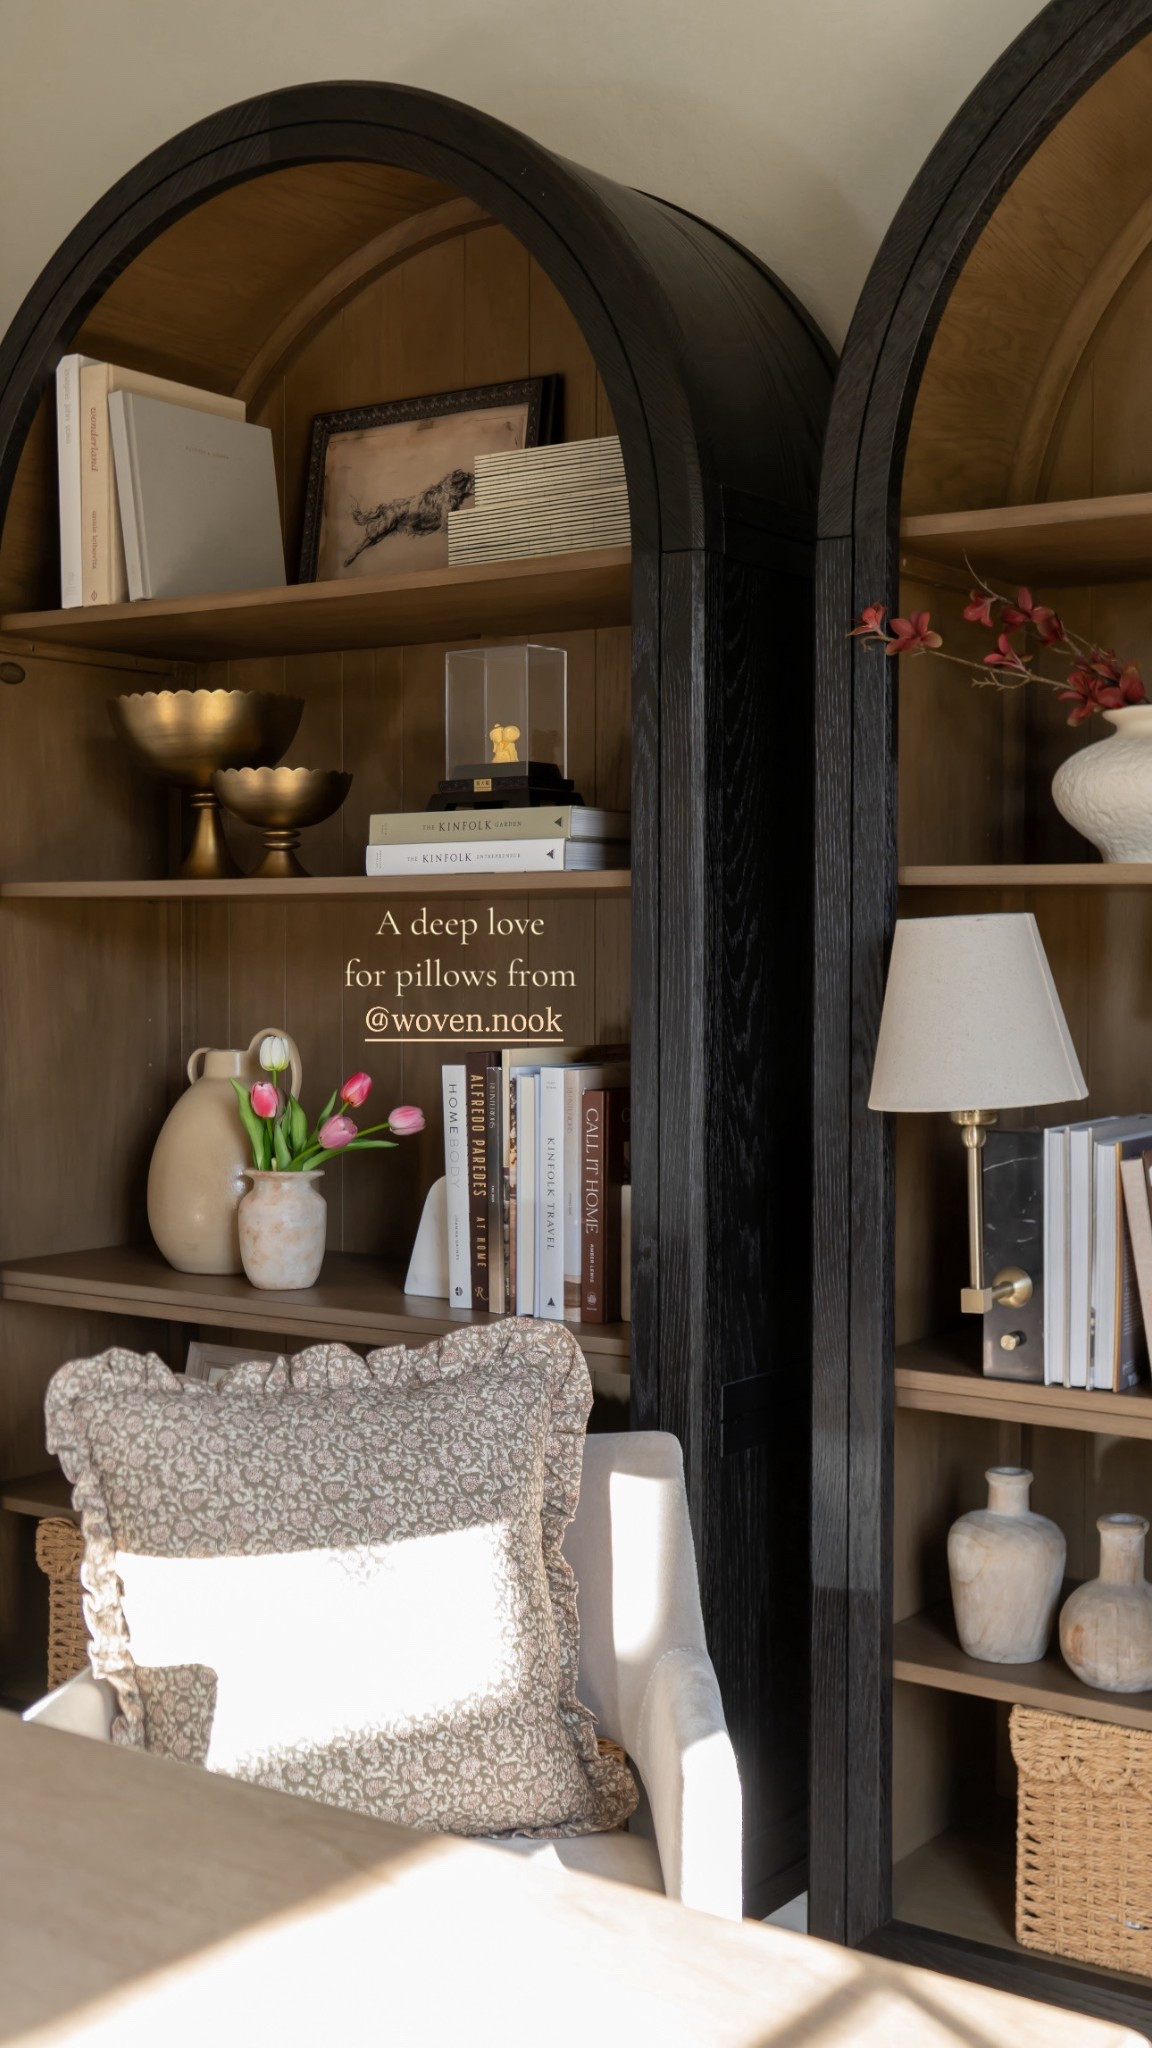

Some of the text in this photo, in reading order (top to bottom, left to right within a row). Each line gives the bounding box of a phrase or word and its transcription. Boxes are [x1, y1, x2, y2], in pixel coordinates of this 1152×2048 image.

[89, 407, 99, 473] wonderland
[422, 852, 472, 863] KINFOLK
[438, 820, 492, 832] KINFOLK
[448, 1083, 461, 1190] HOMEBODY
[470, 1074, 487, 1268] ALFREDO PAREDES AT HOME
[585, 1108, 599, 1234] CALL IT HOME
[546, 1137, 556, 1250] KINFOLK TRAVEL
